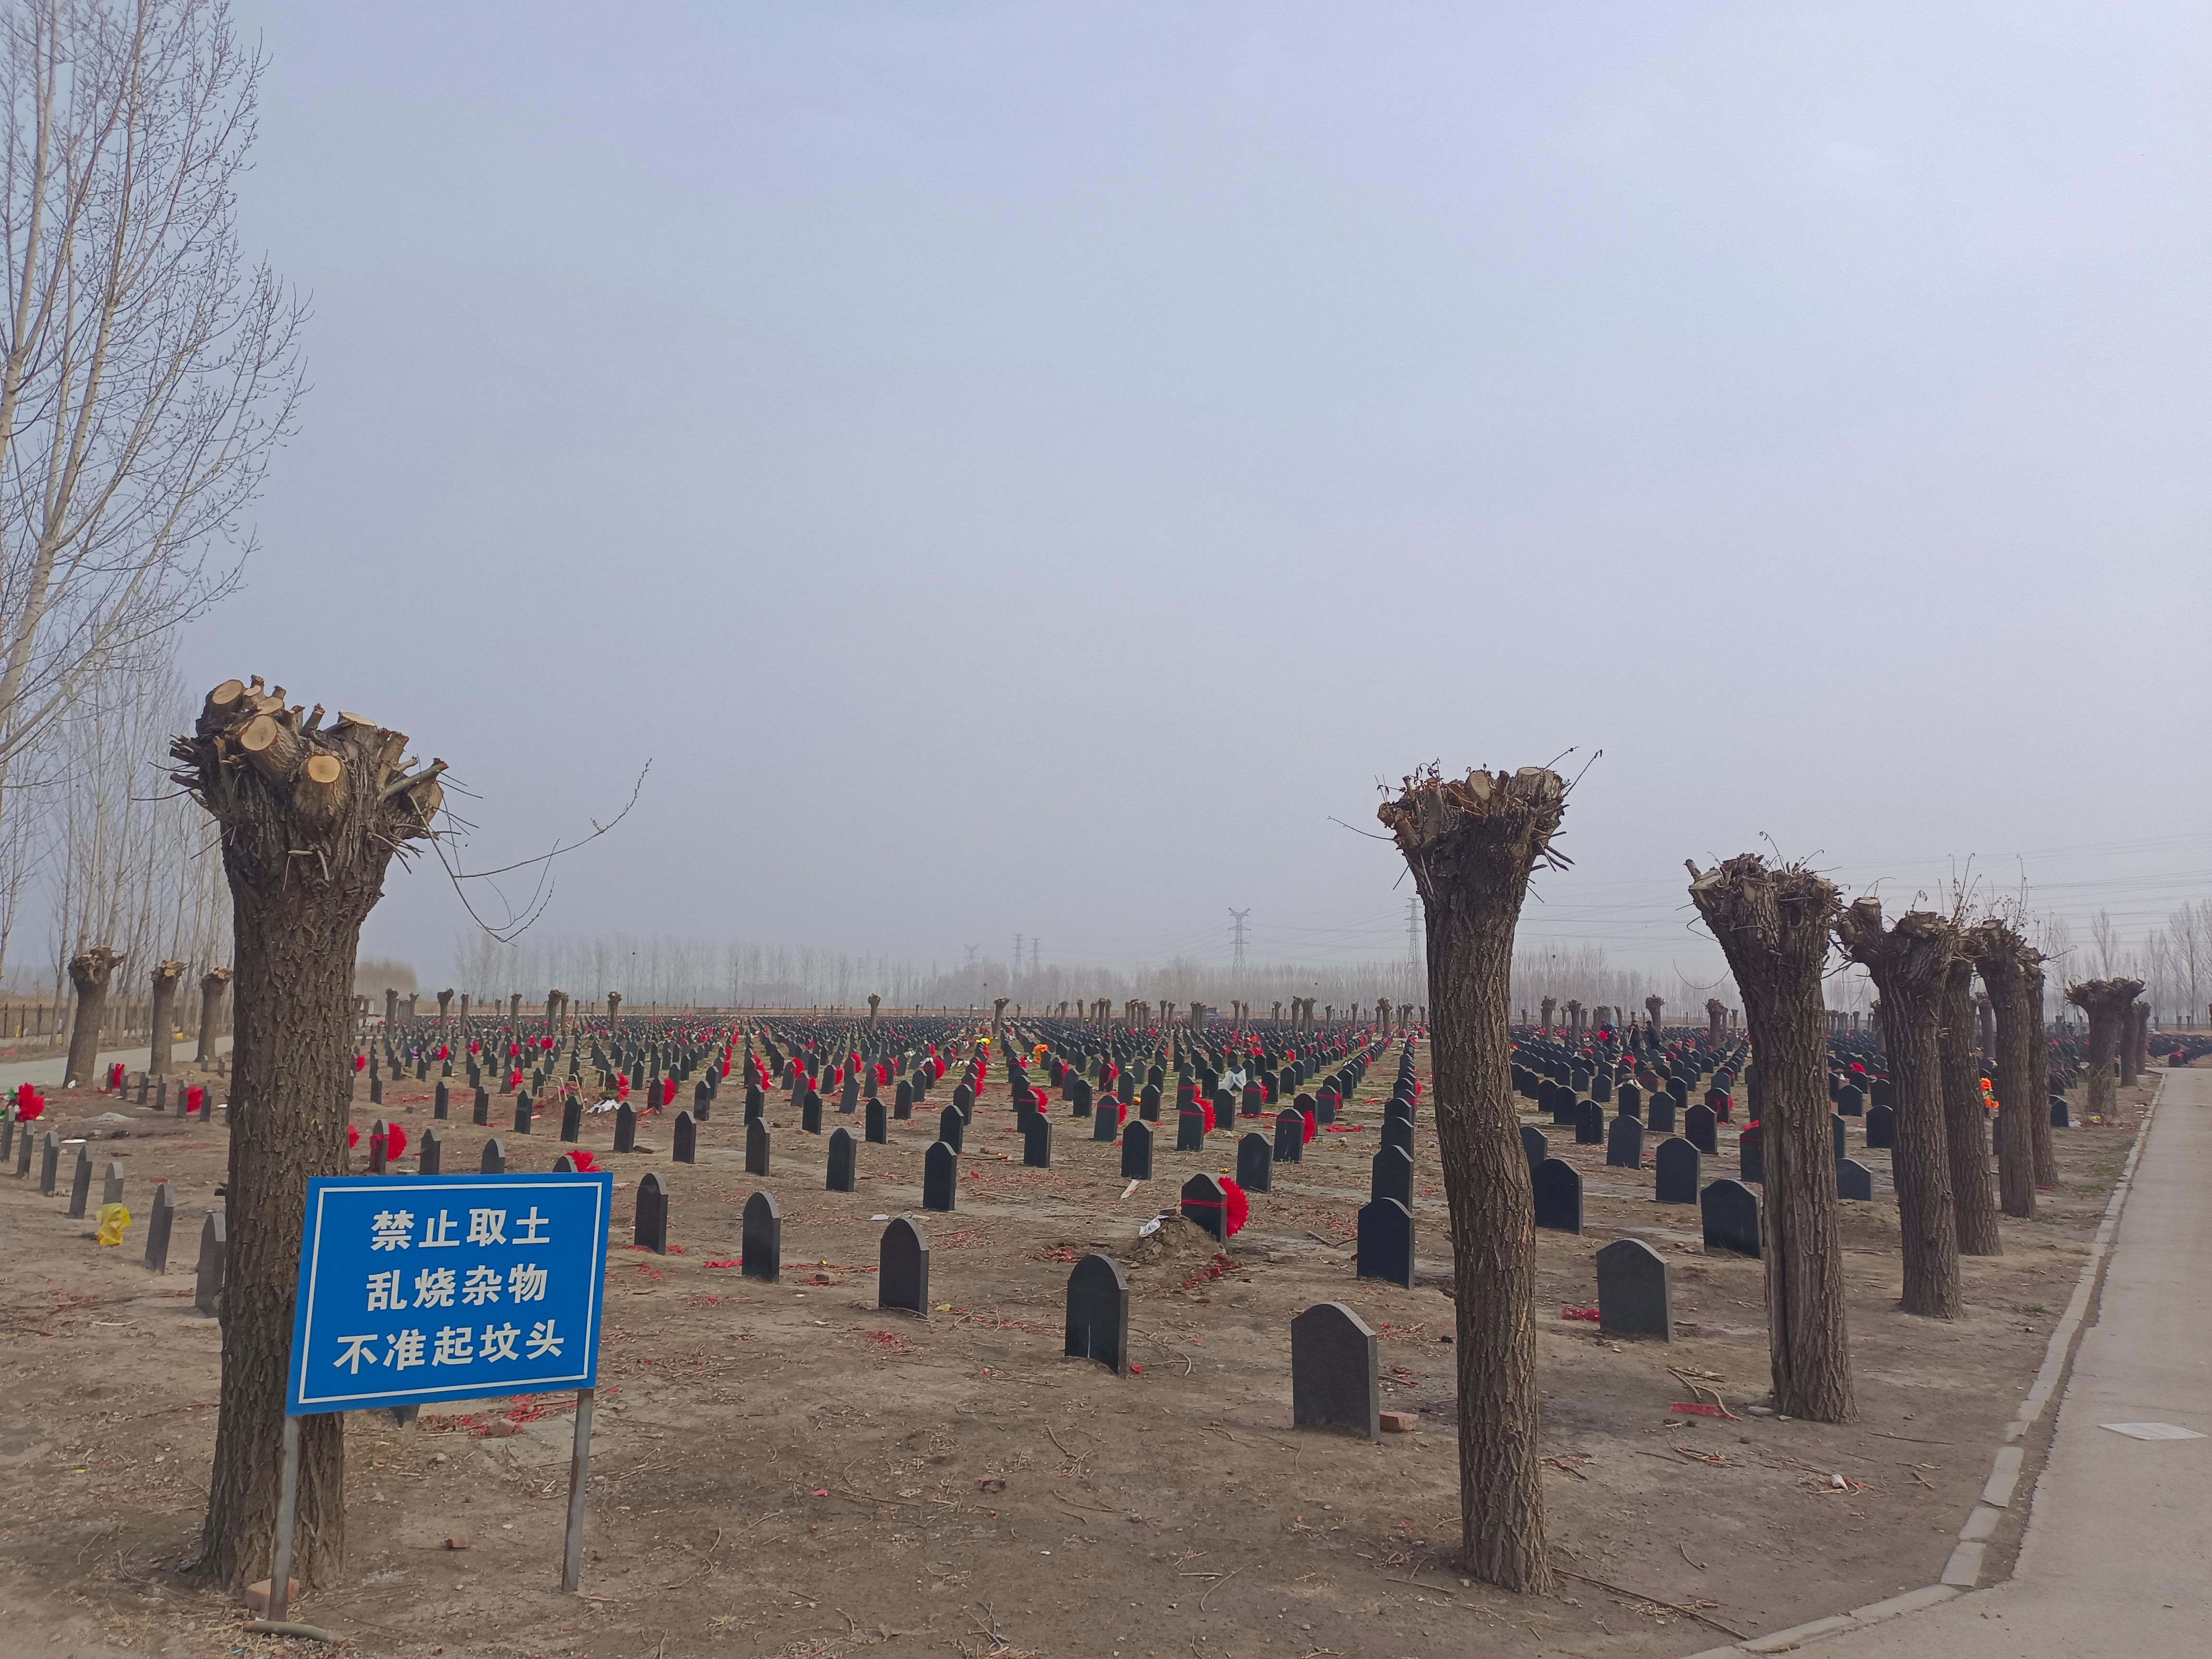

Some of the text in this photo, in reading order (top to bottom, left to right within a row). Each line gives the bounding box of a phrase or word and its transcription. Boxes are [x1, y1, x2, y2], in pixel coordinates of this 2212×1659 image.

[370, 1206, 551, 1252] 禁止取土
[365, 1262, 548, 1312] 乱烧杂物
[333, 1319, 565, 1375] 不准起坟头
